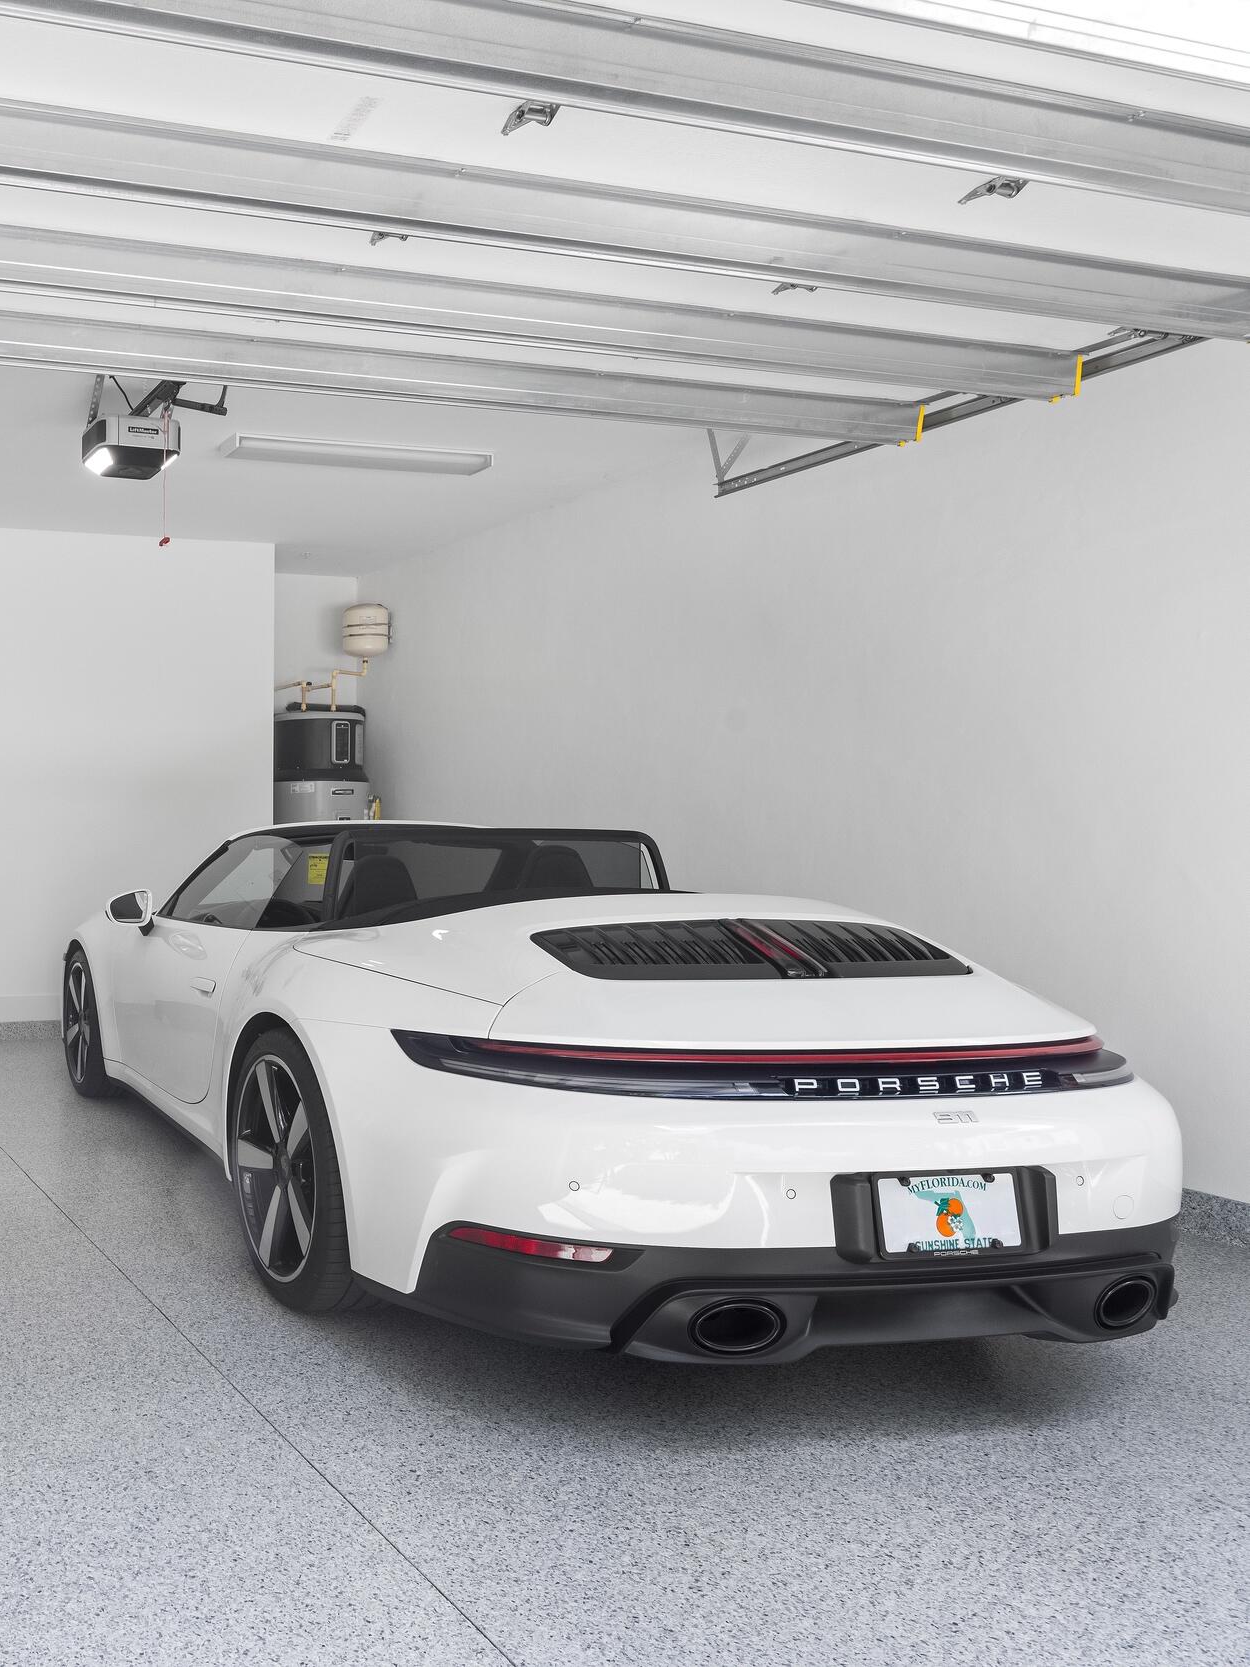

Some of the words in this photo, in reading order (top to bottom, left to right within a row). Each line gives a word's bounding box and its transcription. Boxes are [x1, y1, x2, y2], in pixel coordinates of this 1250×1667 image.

[793, 1070, 1043, 1092] PORSCHE
[932, 1110, 980, 1124] 911
[915, 1238, 960, 1251] SUNSHINE
[964, 1237, 992, 1250] STATE
